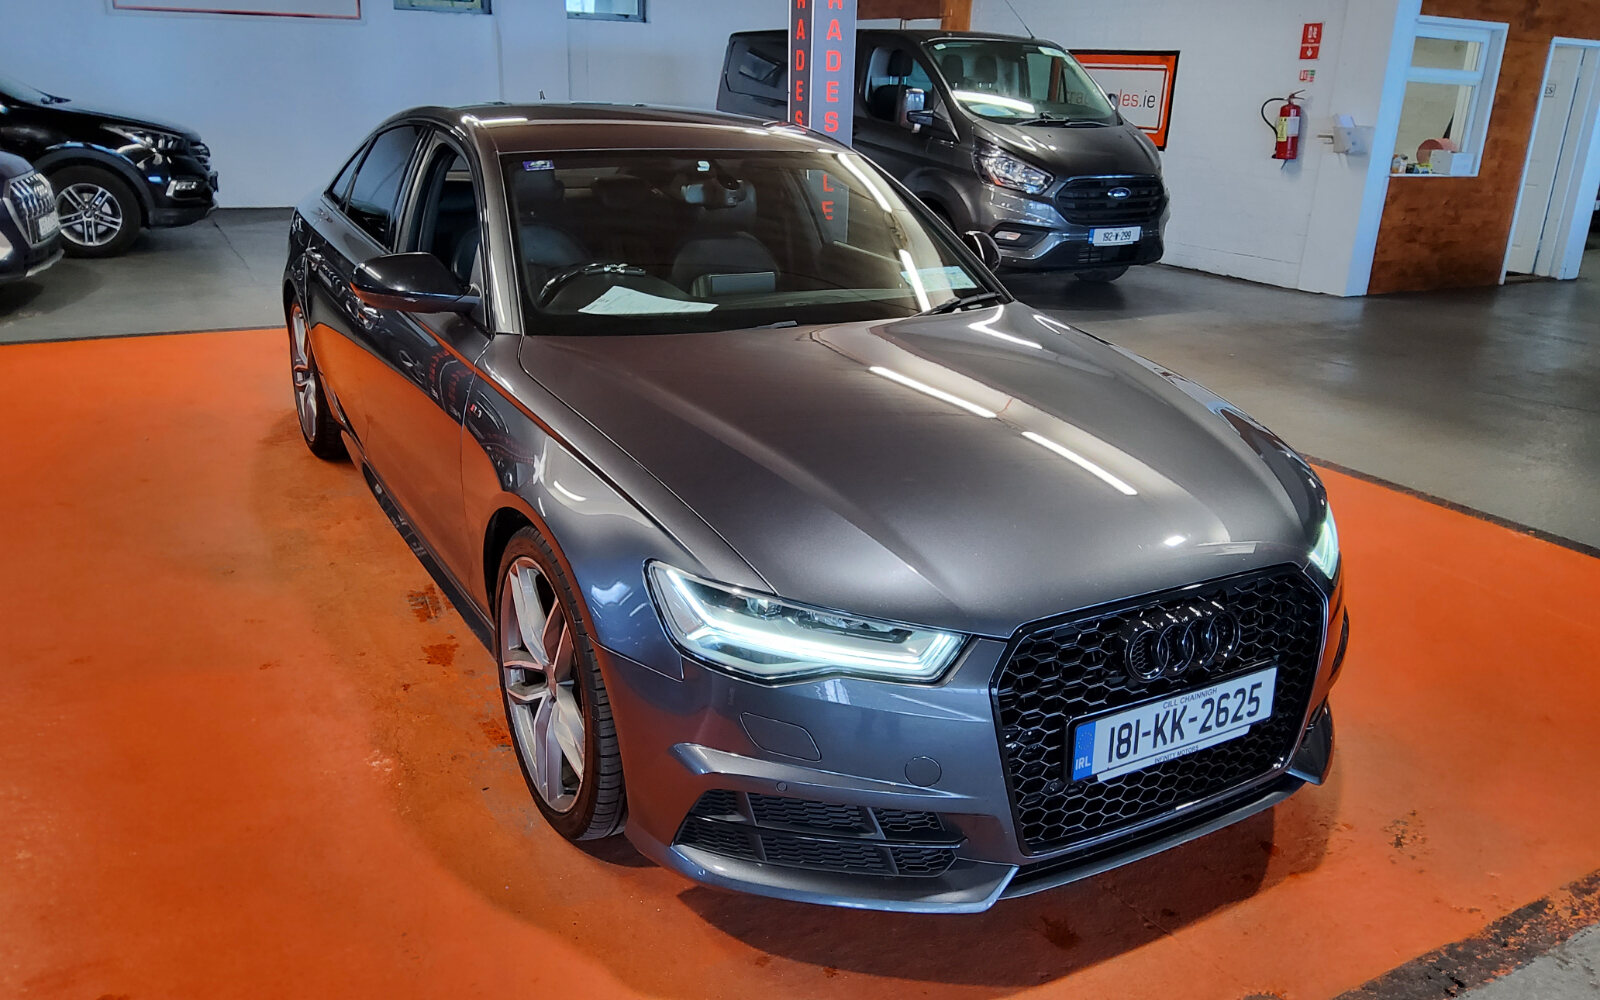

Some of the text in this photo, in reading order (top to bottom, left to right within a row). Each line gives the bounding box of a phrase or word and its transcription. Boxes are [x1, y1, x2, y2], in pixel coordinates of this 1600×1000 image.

[1162, 687, 1217, 710] CILL CHAINNIGH
[1108, 682, 1263, 764] 181-KK-2625
[1075, 756, 1092, 771] IRL
